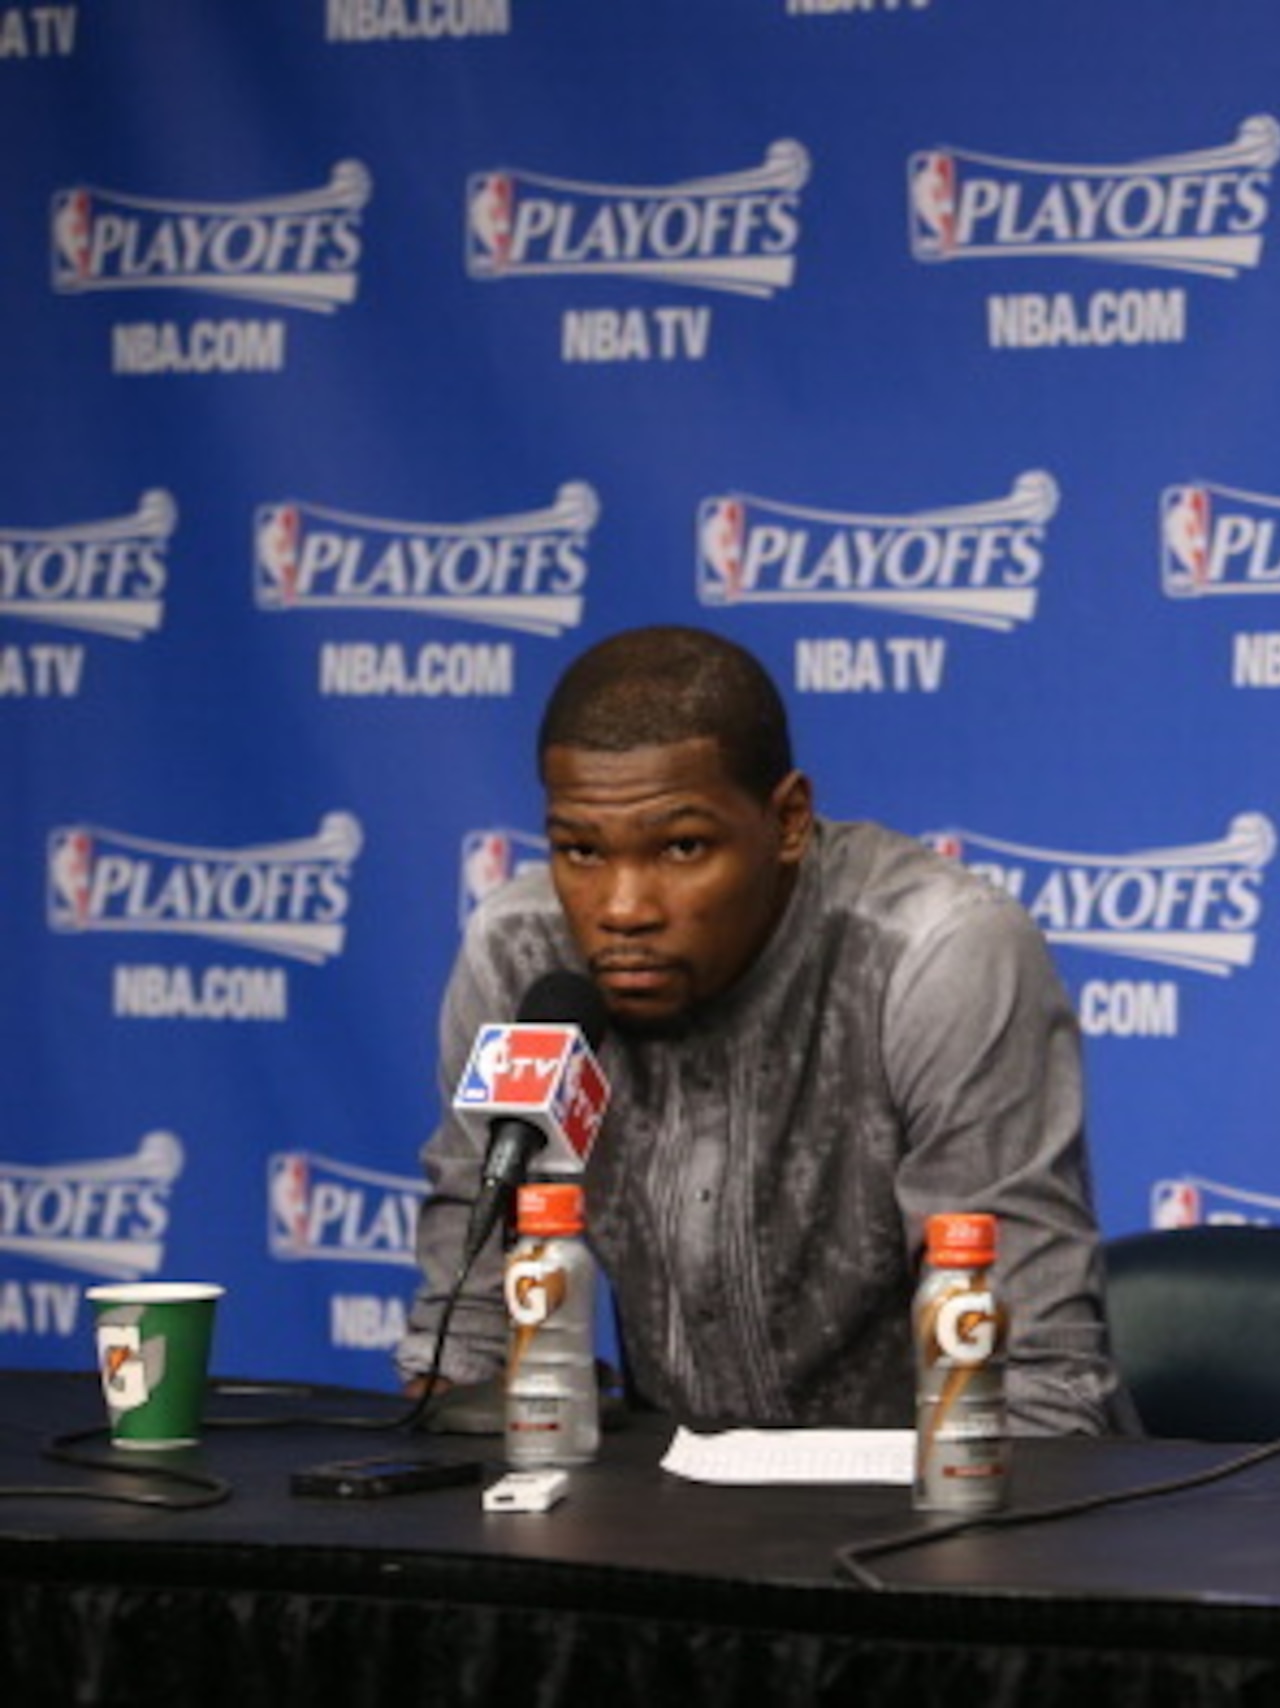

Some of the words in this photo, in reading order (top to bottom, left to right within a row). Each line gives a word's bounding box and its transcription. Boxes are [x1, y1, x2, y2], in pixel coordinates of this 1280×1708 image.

[31, 6, 77, 57] TV
[326, 0, 511, 42] NBA.COM
[510, 194, 801, 263] PLAYOFFS
[955, 170, 1273, 243] PLAYOFFS
[90, 212, 364, 276] PLAYOFFS
[112, 318, 287, 374] NBA.COM
[561, 309, 651, 362] NBA
[653, 307, 711, 360] TV
[987, 289, 1186, 348] NBA.COM
[295, 531, 589, 594] PLAYOFFS
[738, 525, 1045, 589] PLAYOFFS
[29, 645, 84, 697] TV
[319, 642, 514, 697] NBA.COM
[795, 638, 884, 692] NBA
[885, 637, 946, 692] TV
[91, 857, 352, 921] PLAYOFFS
[113, 964, 287, 1020] NBA.COM
[29, 1282, 80, 1336] TV
[936, 1292, 993, 1362] G
